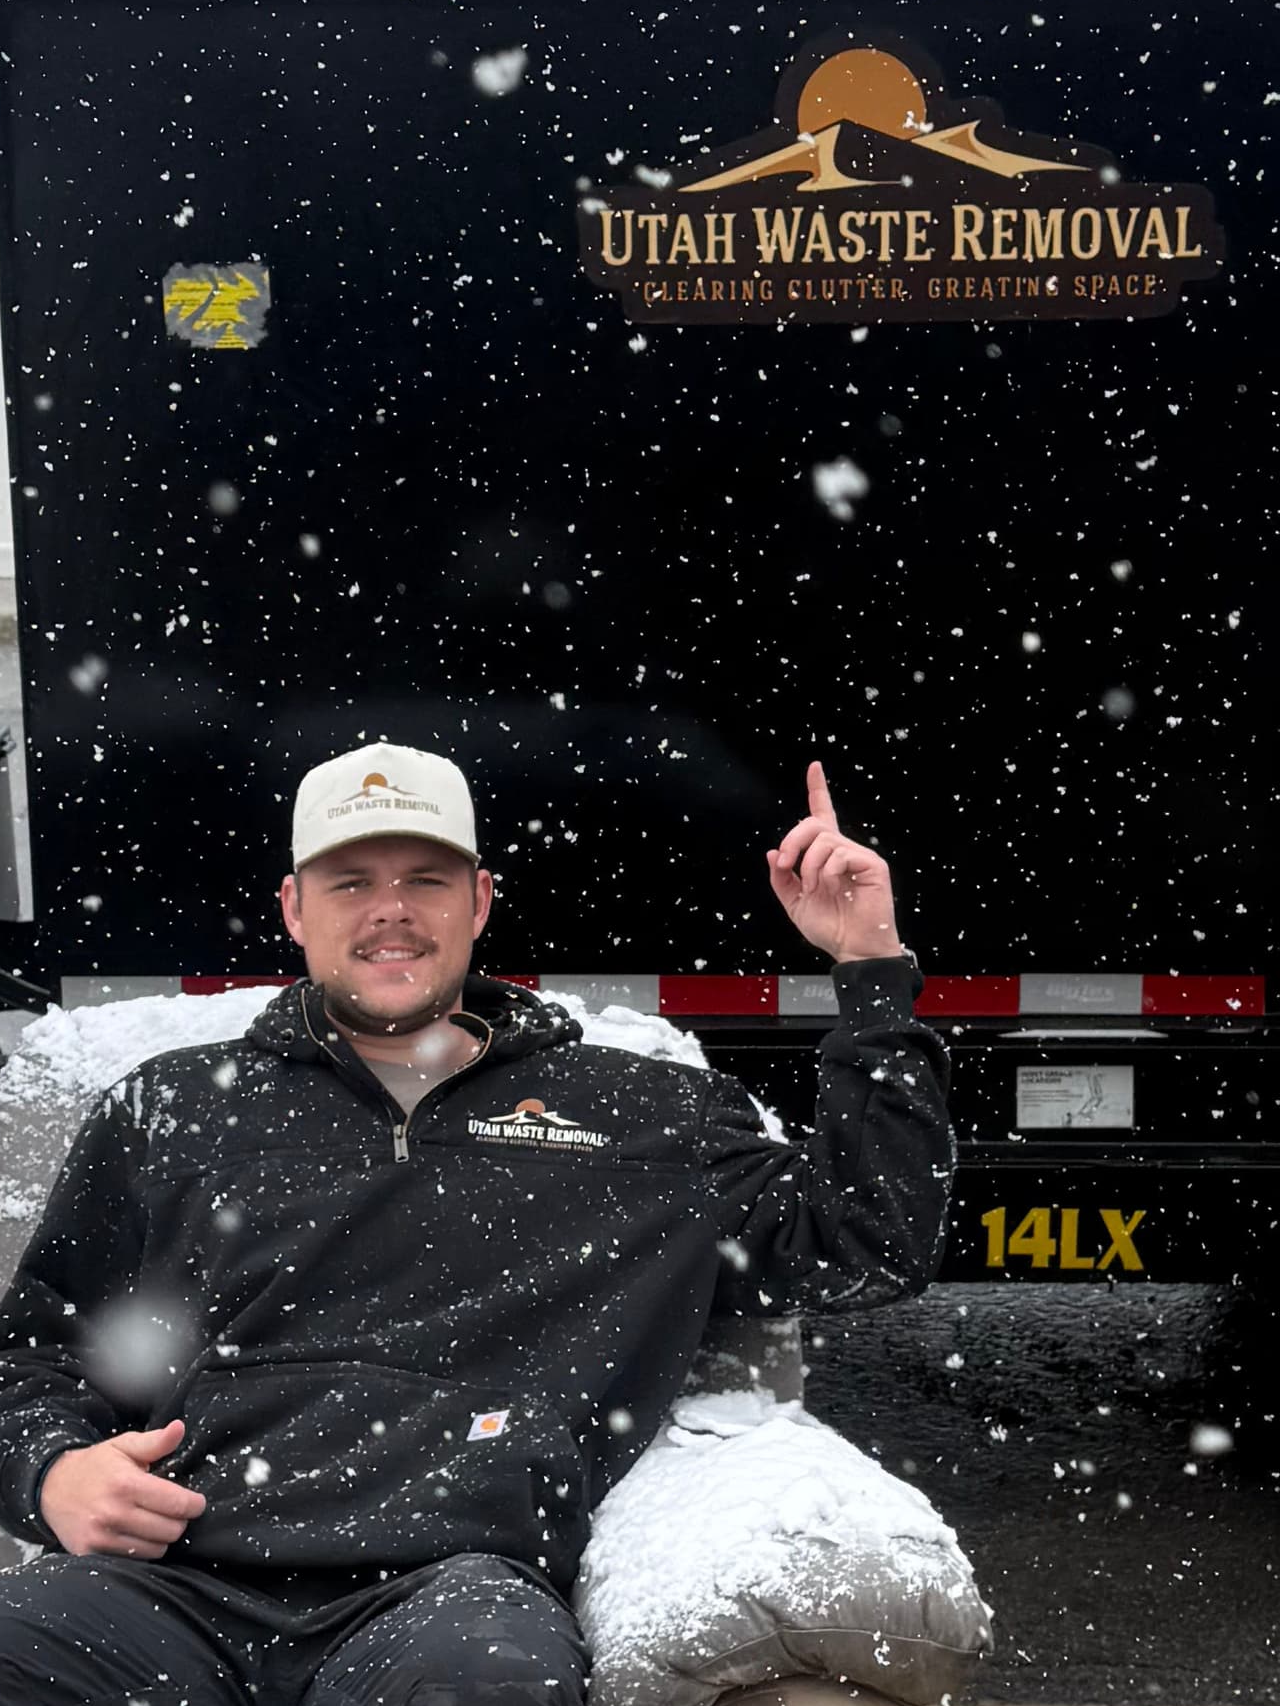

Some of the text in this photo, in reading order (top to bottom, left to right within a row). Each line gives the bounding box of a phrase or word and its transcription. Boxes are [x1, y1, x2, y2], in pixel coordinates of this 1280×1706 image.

[600, 204, 1202, 266] UTAH WASTE REMOVAL
[643, 278, 773, 302] CLEARING
[327, 797, 441, 819] UTAH WASTE REMOVAL
[468, 1119, 605, 1147] UTAH WASTE REMOVAL
[981, 1206, 1147, 1271] 14LX
